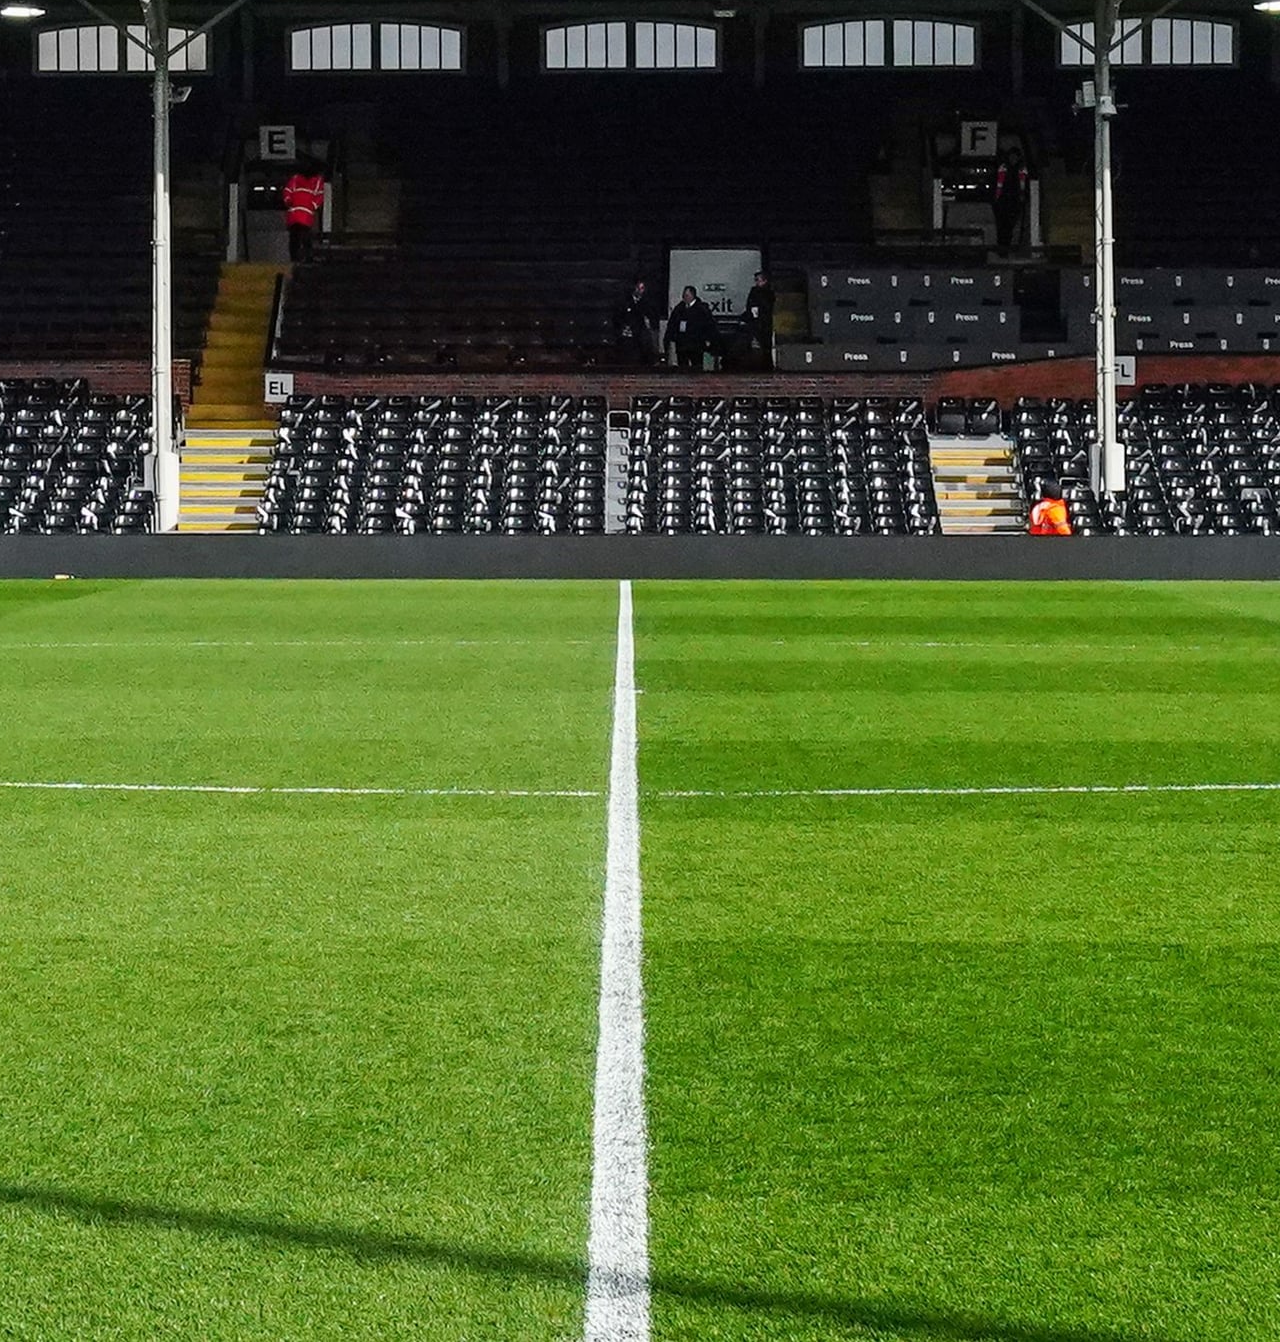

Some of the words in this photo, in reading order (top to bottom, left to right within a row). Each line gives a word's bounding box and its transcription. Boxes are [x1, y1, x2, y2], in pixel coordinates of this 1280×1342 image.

[268, 130, 288, 154] E
[970, 126, 988, 151] F
[847, 276, 871, 285] Press
[950, 276, 974, 285] Press
[1121, 276, 1144, 285] Press
[850, 313, 874, 322] Press
[955, 313, 979, 322] Press
[1128, 314, 1151, 323] Press
[1170, 340, 1193, 349] Press
[844, 352, 868, 361] Press
[991, 352, 1016, 360] Press
[269, 381, 289, 395] EL
